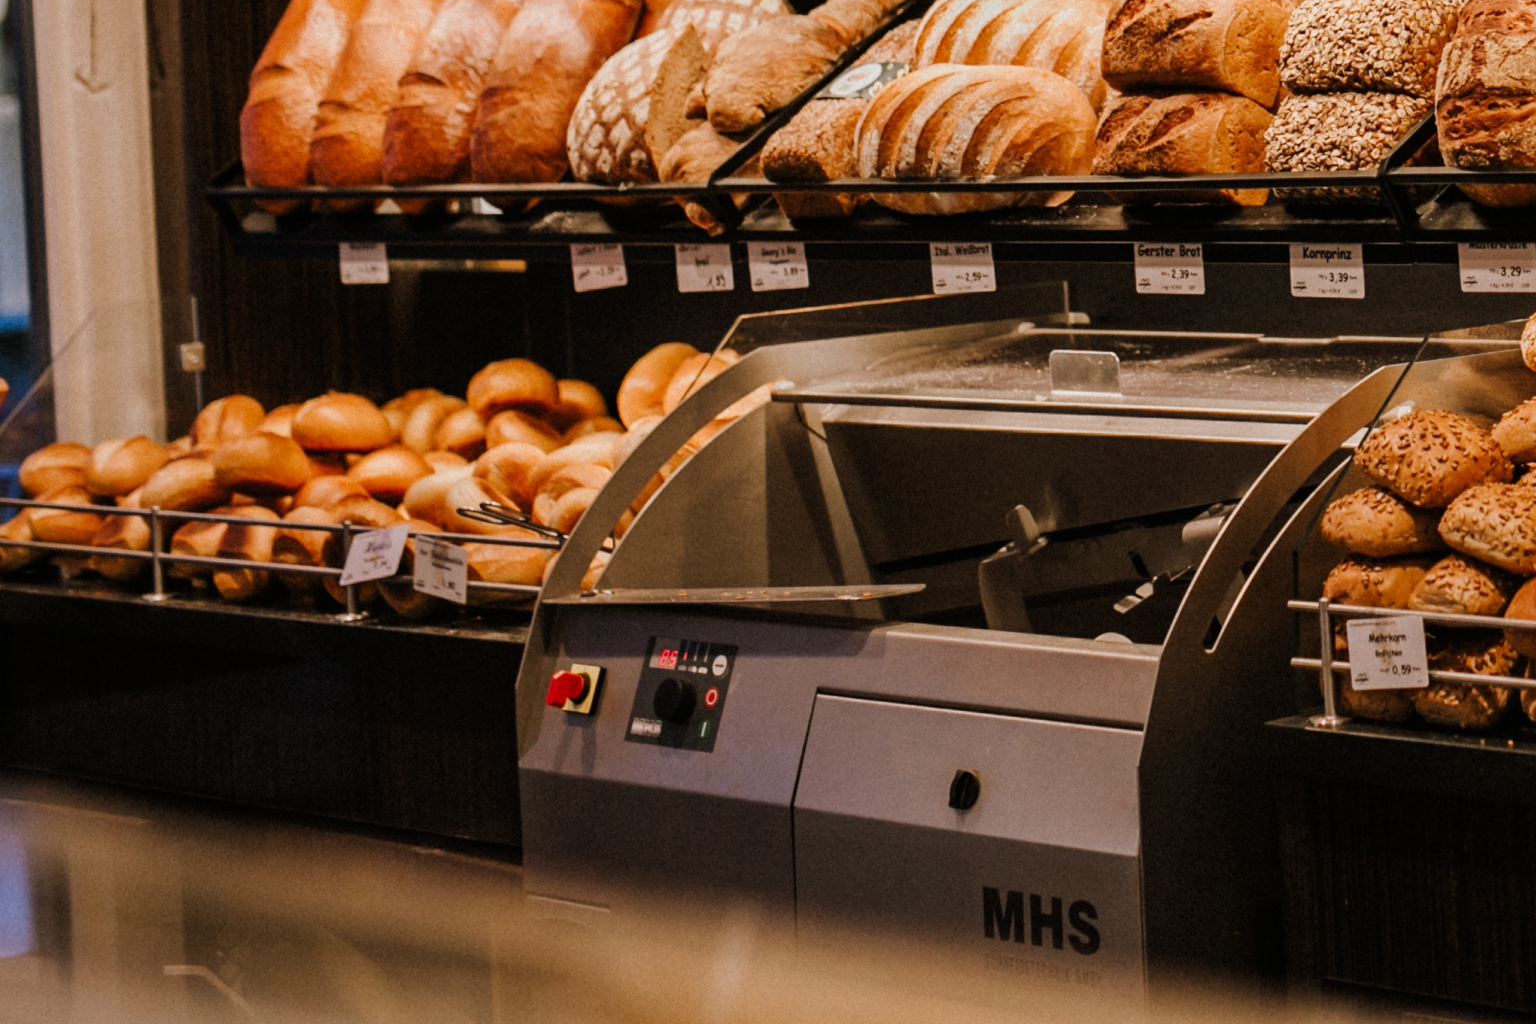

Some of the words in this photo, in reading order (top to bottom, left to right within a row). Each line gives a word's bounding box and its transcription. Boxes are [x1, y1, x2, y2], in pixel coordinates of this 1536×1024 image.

[1138, 244, 1175, 257] Gerster
[1179, 245, 1201, 257] Brot
[1302, 246, 1352, 263] Kornprinz
[1171, 269, 1189, 280] 2,39
[1329, 272, 1349, 284] 3,39
[1500, 266, 1521, 279] 3,29
[1369, 633, 1406, 643] Mehrkorn
[1392, 665, 1411, 676] 0,59
[983, 886, 1100, 956] MHS
